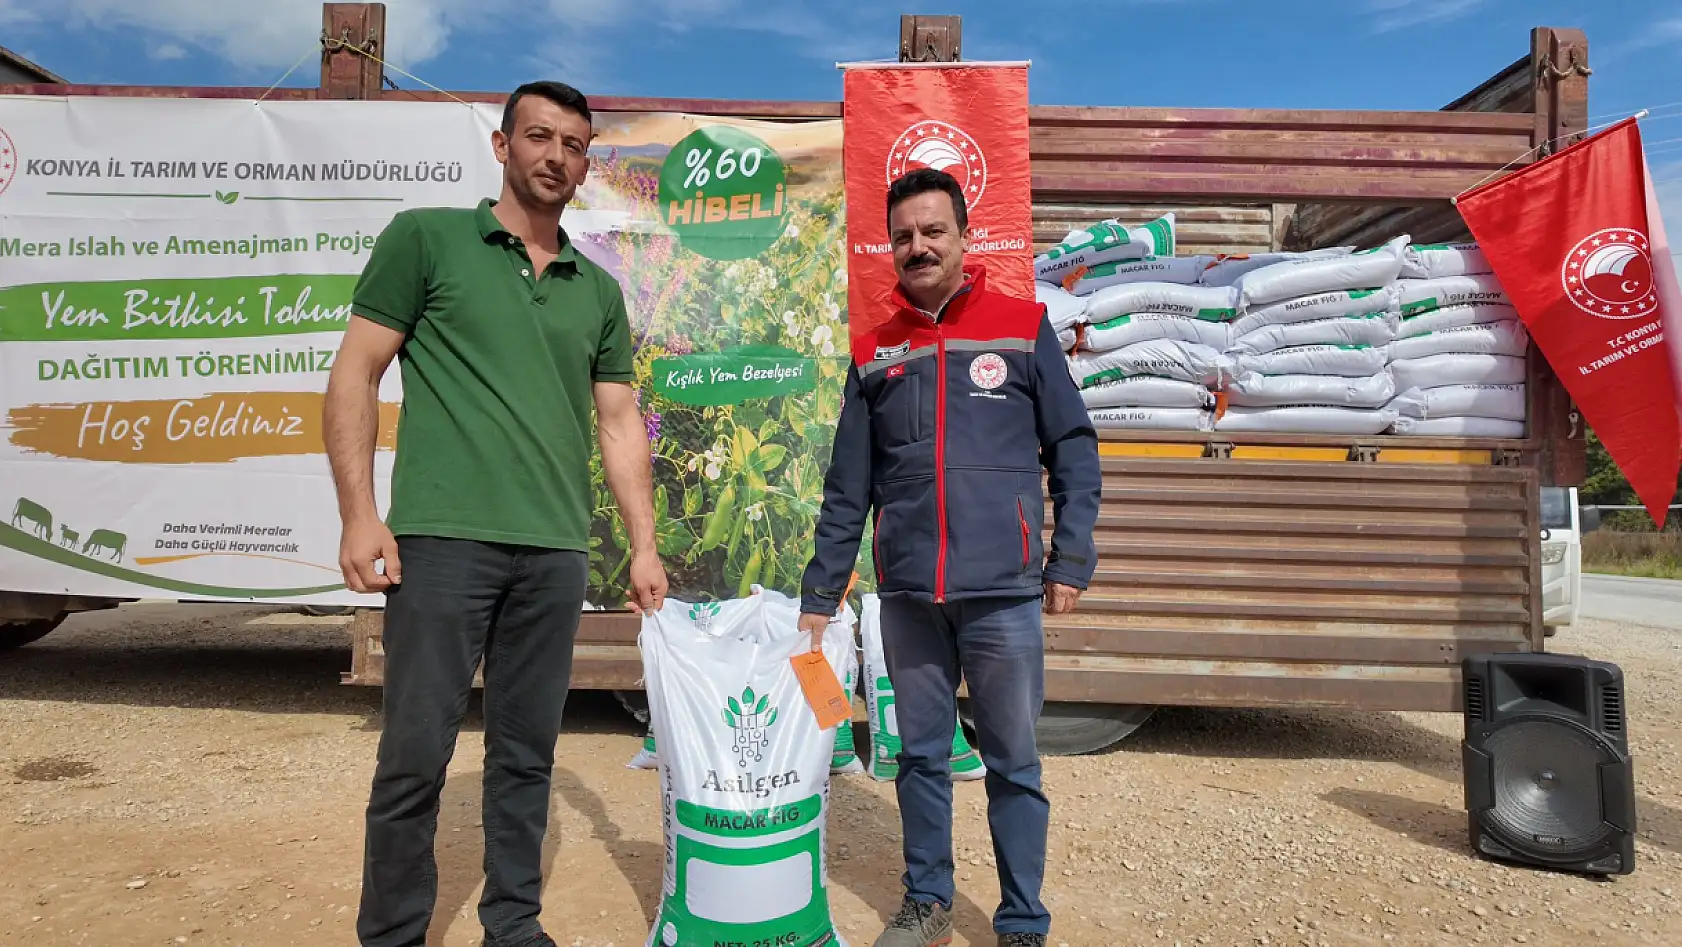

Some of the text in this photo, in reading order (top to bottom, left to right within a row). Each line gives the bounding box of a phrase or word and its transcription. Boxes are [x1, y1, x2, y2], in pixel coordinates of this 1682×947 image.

[26, 156, 463, 183] KONYA İL TARIM VE ORMAN MÜDÜRLÜĞÜ
[683, 147, 762, 189] %60
[668, 183, 784, 226] HİBELİ
[0, 230, 378, 262] Mera Islah ve Amenajman Proje
[41, 290, 109, 329] Yem
[123, 287, 249, 330] Bitkisi
[38, 347, 340, 381] DAĞITIM TÖRENİMİZ
[709, 365, 738, 385] Yem
[742, 362, 804, 383] Bezelyesi
[78, 399, 304, 450] Hoş Geldiniz
[1093, 413, 1127, 421] MACAR
[163, 523, 292, 537] Daha Verimli Meralar
[154, 539, 299, 553] Daha Güçlü Hayvancılık
[702, 769, 801, 798] Asilgen
[705, 812, 767, 831] MACAR
